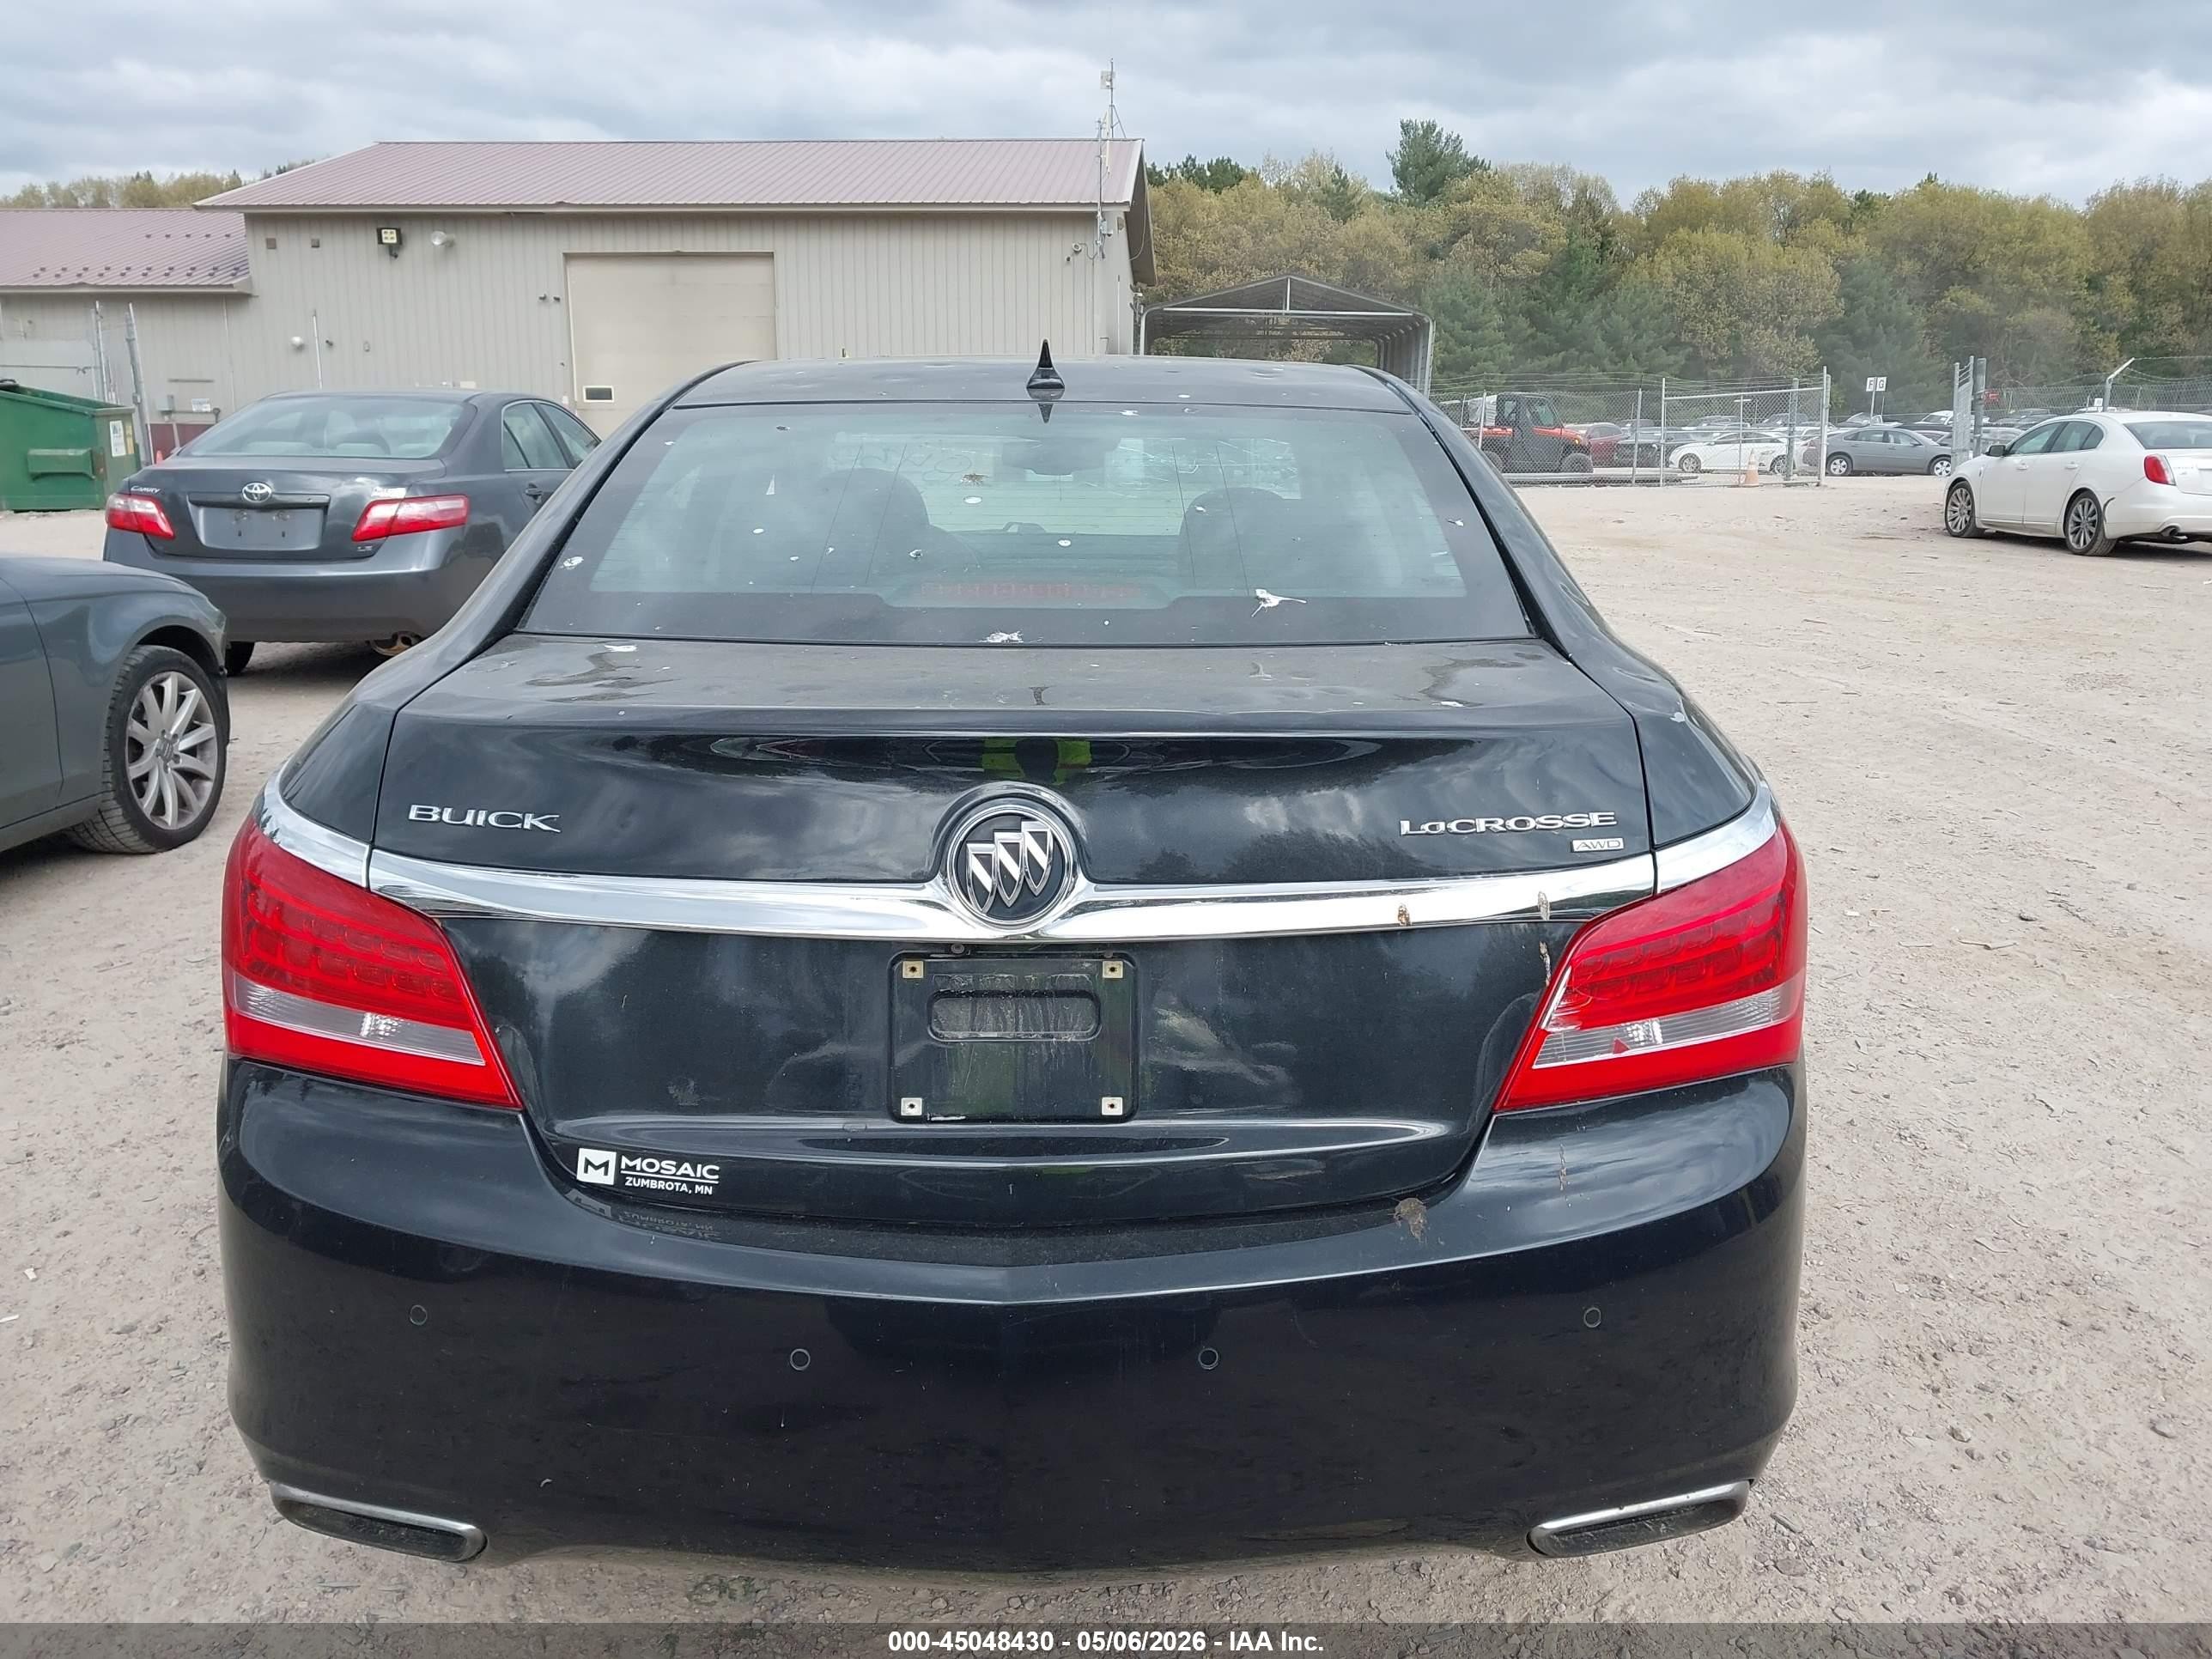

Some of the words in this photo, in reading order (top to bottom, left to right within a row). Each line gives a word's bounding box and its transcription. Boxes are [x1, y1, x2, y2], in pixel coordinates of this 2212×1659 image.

[408, 804, 561, 833] BUICK
[1576, 839, 1621, 849] AWD
[620, 1155, 720, 1180] MOSAIC
[625, 1176, 692, 1194] ZUMBROTA,
[695, 1184, 713, 1195] MN
